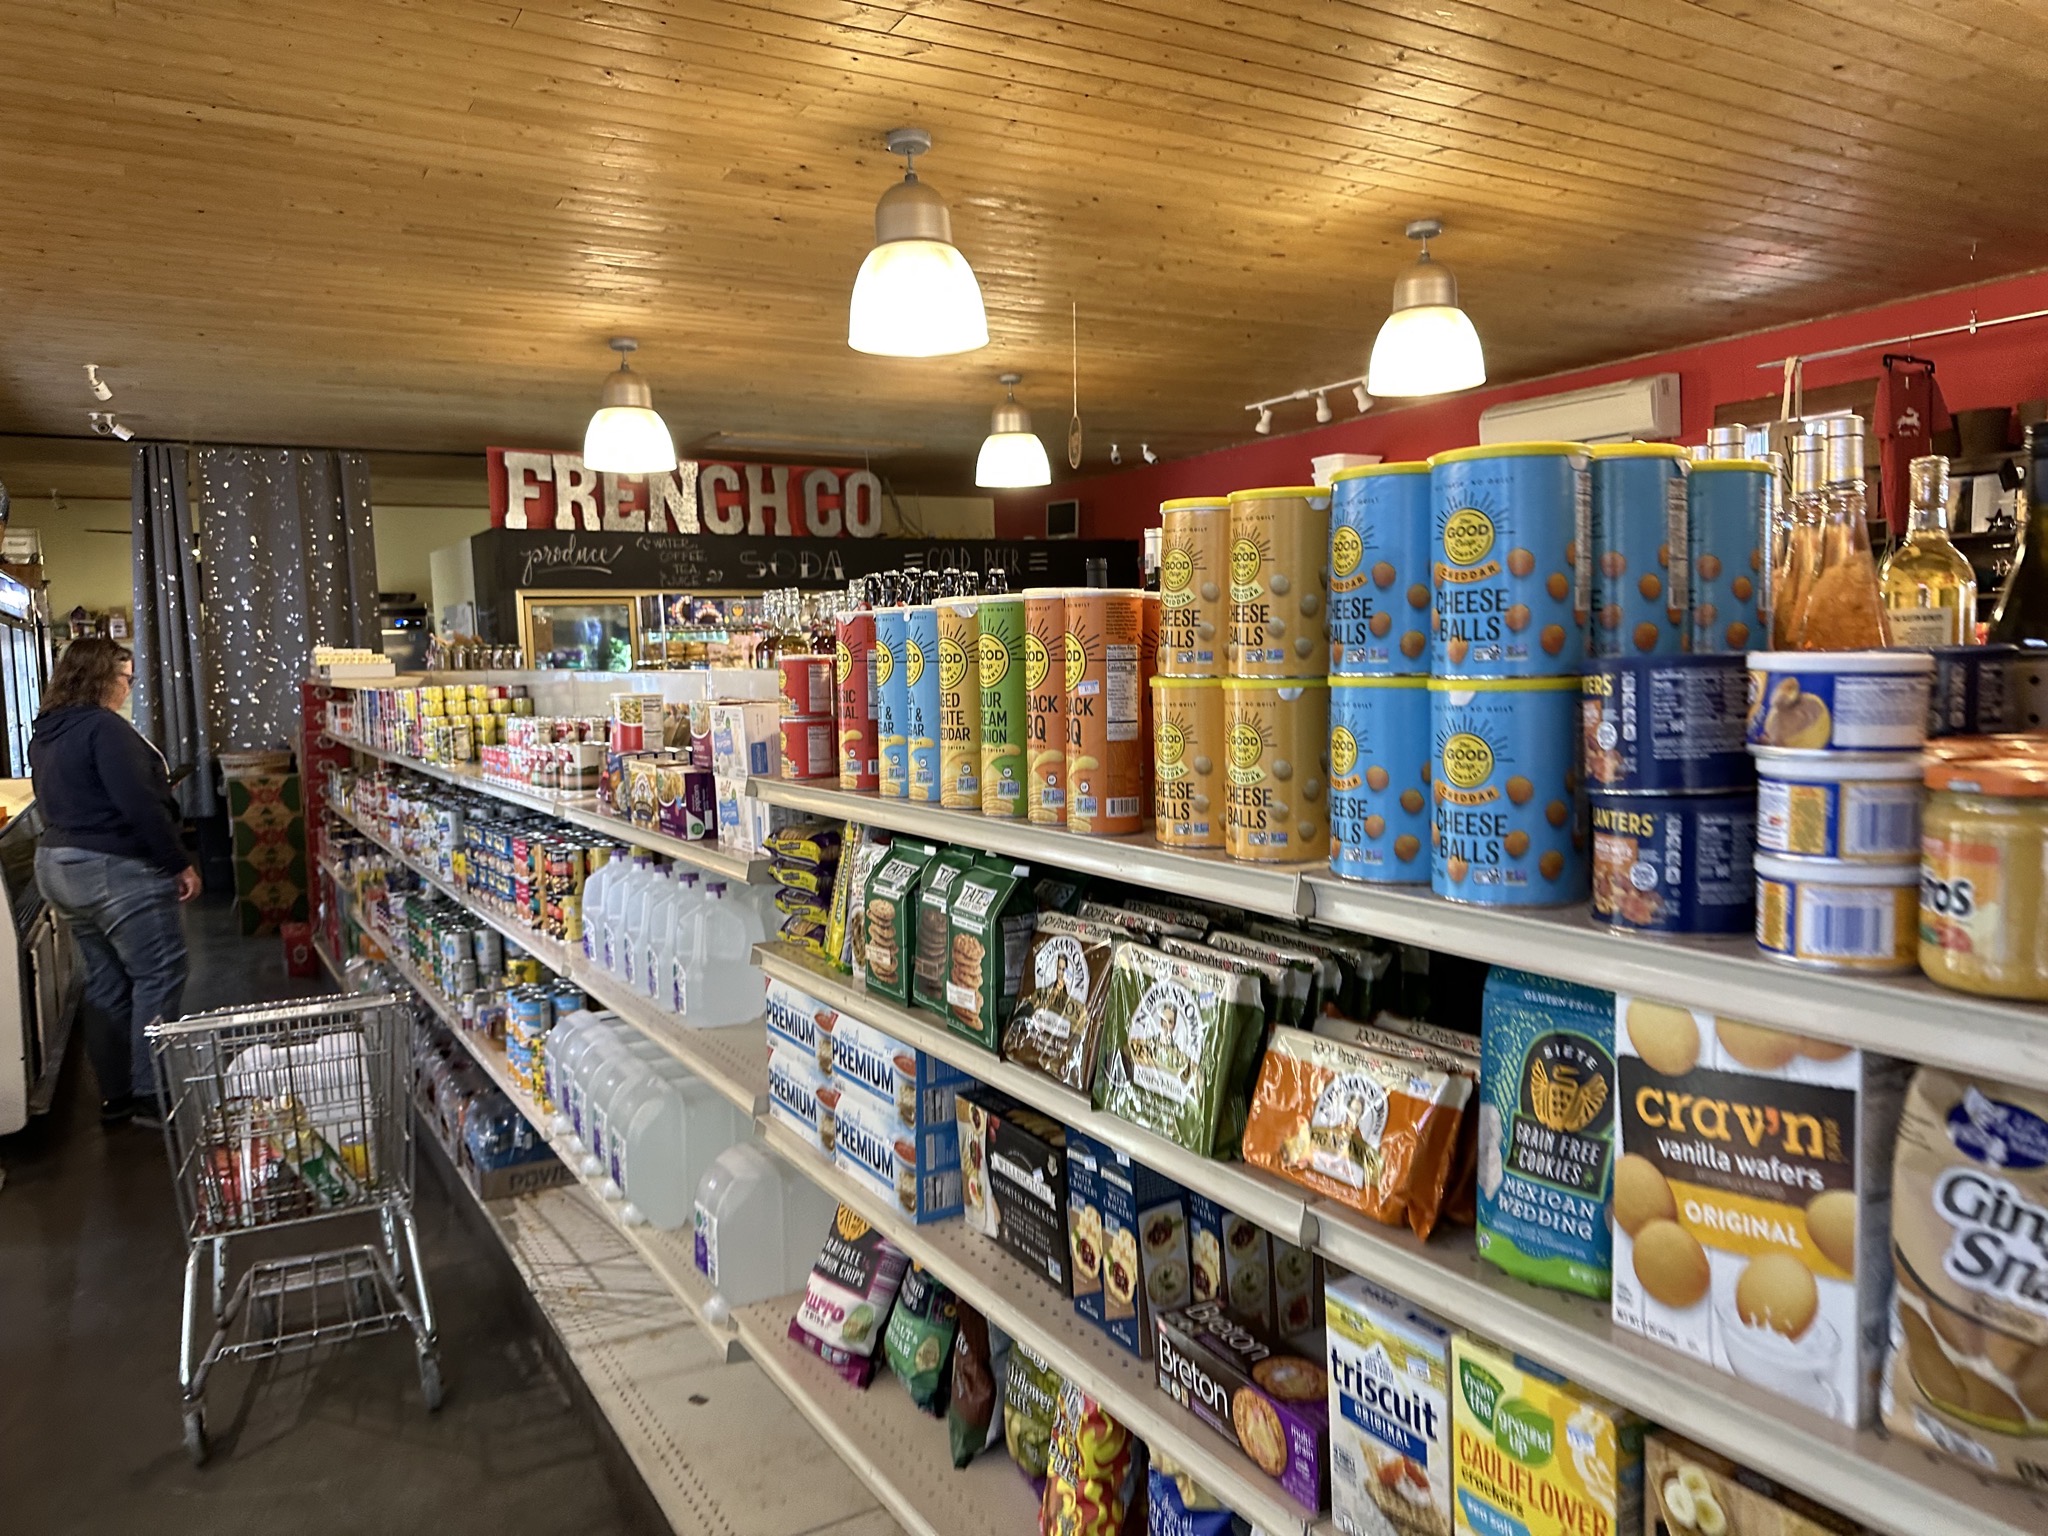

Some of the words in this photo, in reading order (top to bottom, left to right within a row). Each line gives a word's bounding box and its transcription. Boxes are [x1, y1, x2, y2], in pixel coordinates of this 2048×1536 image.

[804, 465, 882, 538] CO
[1446, 524, 1490, 540] GOOD
[520, 534, 624, 586] produce
[740, 550, 845, 581] SODA
[927, 547, 971, 573] COLD
[1165, 562, 1190, 570] GOOD
[1232, 552, 1257, 562] GOOD
[1440, 564, 1497, 582] CHEDDAR
[1230, 604, 1271, 624] HEESE
[1436, 588, 1510, 614] CHEESE
[1440, 616, 1501, 643] BALLS
[980, 650, 1005, 661] OOD
[981, 691, 1002, 709] OUR
[941, 710, 965, 726] HITE
[1027, 714, 1046, 743] BQ
[1157, 735, 1181, 744] GOOD
[1230, 735, 1259, 746] GOOD
[1446, 748, 1489, 762] GOOD
[1440, 786, 1496, 804] CHEDDAR
[1156, 799, 1190, 821] BALLS
[1227, 806, 1268, 830] BALLS
[1436, 807, 1509, 838] CHEESE
[1440, 837, 1500, 866] BALLS
[766, 998, 816, 1049] PREMIUM
[832, 1035, 894, 1095] PREMIUM
[769, 1068, 817, 1123] PREMIUM
[835, 1114, 894, 1180] PREMIUM
[1515, 1121, 1554, 1154] GRAIN
[1559, 1133, 1600, 1167] FREE
[1517, 1148, 1583, 1186] COOKIES
[1656, 1135, 1731, 1174] vanilla
[1735, 1151, 1826, 1192] wafers
[992, 1175, 1023, 1205] ASSORTED
[1024, 1196, 1059, 1231] CRACKERS
[1069, 1177, 1098, 1200] CRACKERS
[1503, 1175, 1597, 1223] MEXICAN
[1103, 1197, 1134, 1223] CRACKERS
[1498, 1195, 1594, 1243] WEDDING
[1684, 1199, 1803, 1250] ORIGINAL
[838, 1262, 866, 1288] CHIPS
[1185, 1299, 1270, 1362] Breton
[1158, 1332, 1230, 1419] Breton
[1331, 1346, 1439, 1442] triscuit
[1469, 1392, 1492, 1420] the
[1353, 1401, 1412, 1449] ORIGINAL
[1498, 1410, 1552, 1454] ground
[1459, 1429, 1609, 1536] CAULIFLOWER
[1461, 1465, 1525, 1519] crackers
